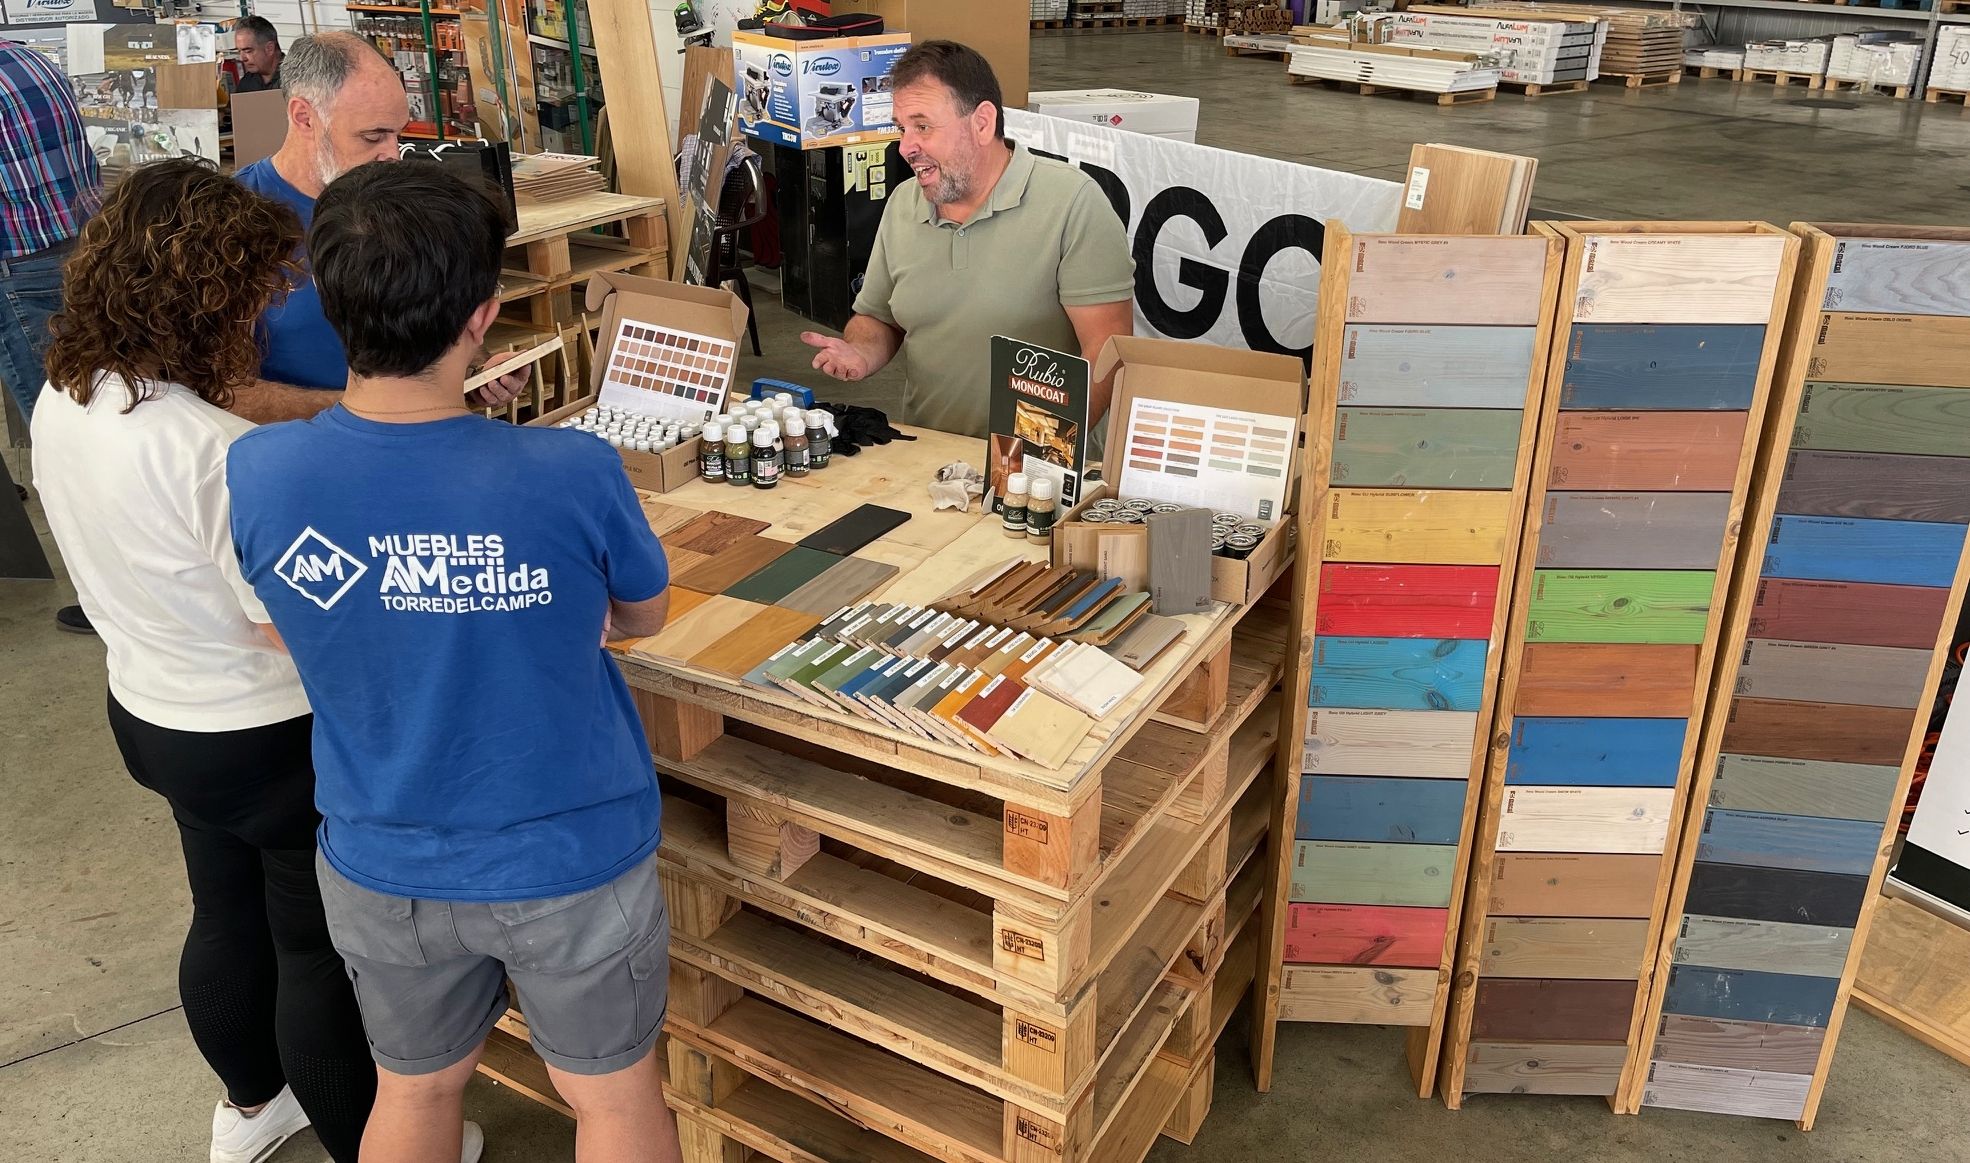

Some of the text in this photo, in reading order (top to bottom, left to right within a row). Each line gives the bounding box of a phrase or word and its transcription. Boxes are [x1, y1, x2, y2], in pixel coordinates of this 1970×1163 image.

[767, 53, 792, 72] Virutex
[802, 60, 840, 76] Virutex
[1012, 348, 1065, 388] Rubio
[1011, 377, 1066, 405] MONOCOAT
[368, 534, 504, 558] MUEBLES
[292, 554, 345, 582] AM
[380, 590, 553, 614] TORREDELCAMPO
[1030, 1037, 1037, 1045] HT
